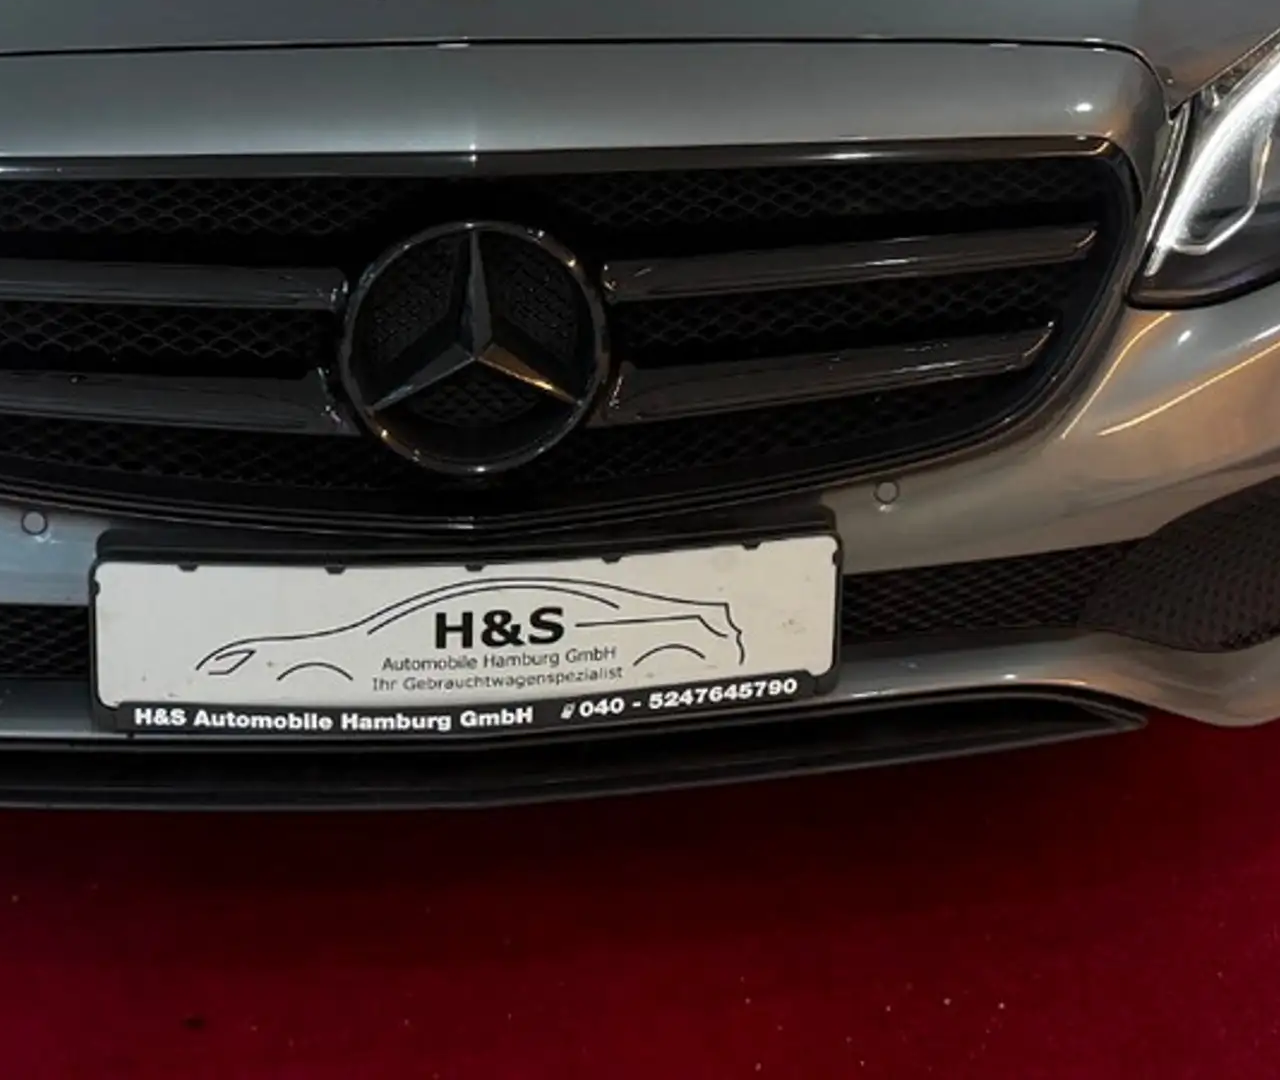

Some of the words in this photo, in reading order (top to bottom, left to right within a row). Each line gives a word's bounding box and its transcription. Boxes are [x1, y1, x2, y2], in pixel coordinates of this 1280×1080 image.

[434, 606, 565, 649] H&S
[381, 653, 478, 672] Automobile
[483, 650, 560, 669] Hamburg
[565, 646, 617, 664] GmbH
[372, 677, 398, 691] Ihr
[403, 666, 623, 691] Gebrauchtwagenspezialist
[579, 697, 625, 718] 040
[648, 677, 798, 710] 5247645790
[134, 707, 187, 727] H&S
[193, 708, 334, 731] Automobile
[341, 709, 452, 732] Hamburg
[459, 706, 534, 728] GmbH
